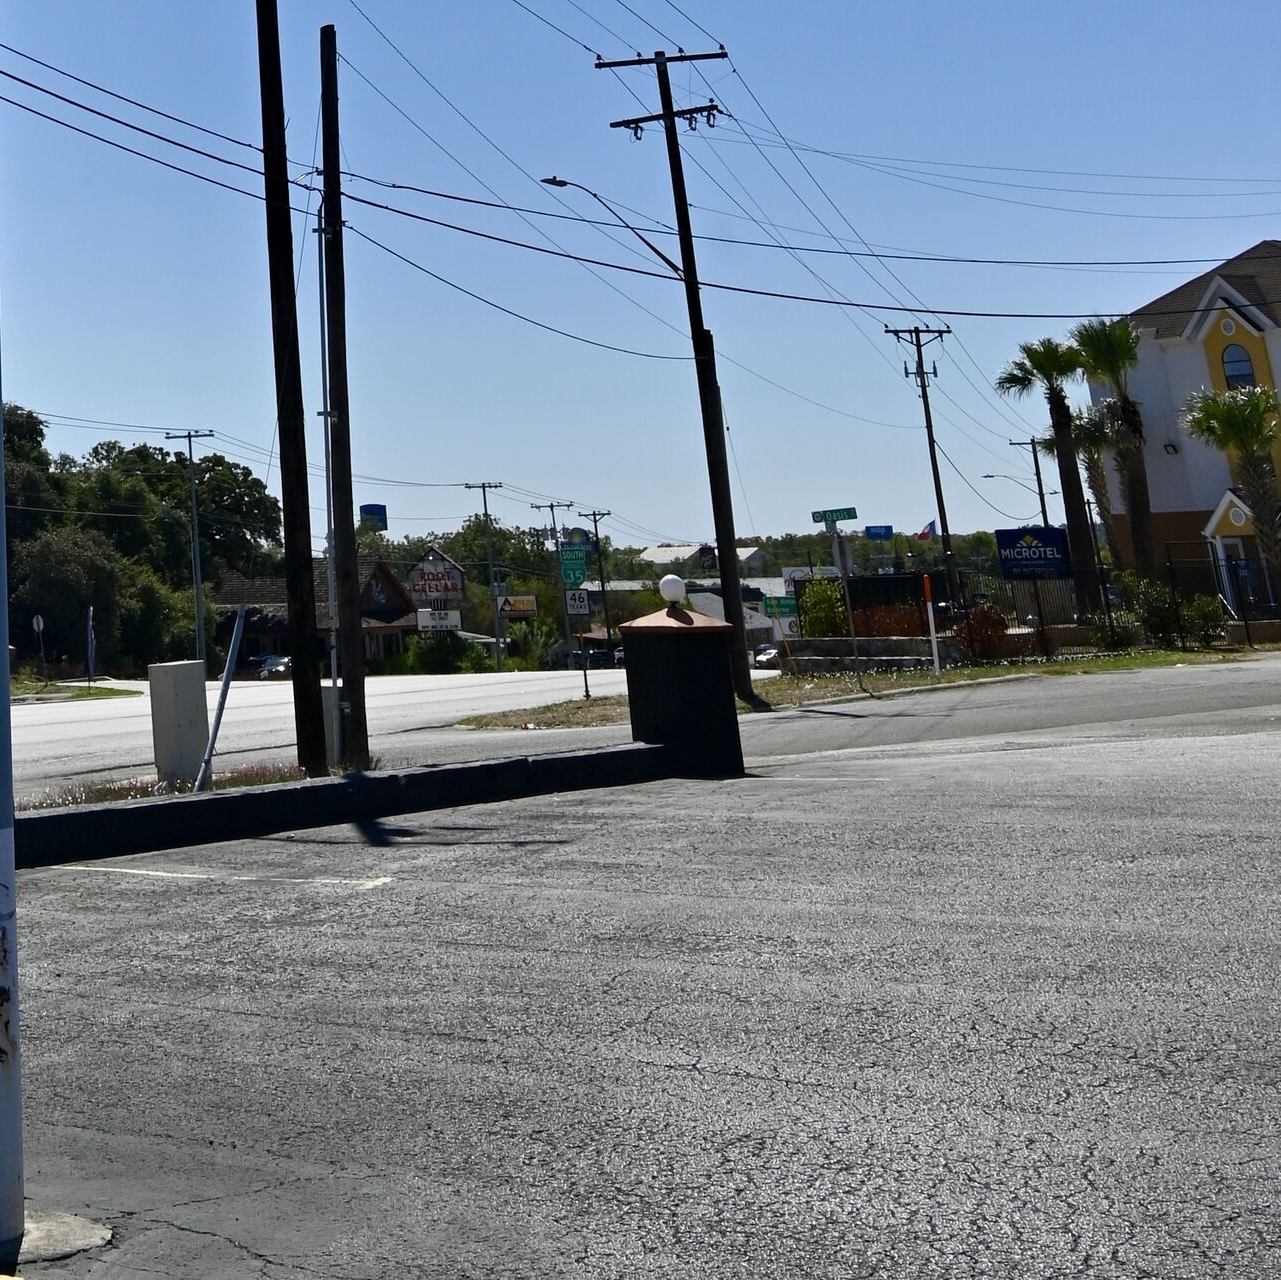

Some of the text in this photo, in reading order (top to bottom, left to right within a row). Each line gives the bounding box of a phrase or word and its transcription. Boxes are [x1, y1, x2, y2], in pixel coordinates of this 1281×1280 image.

[826, 511, 849, 521] Oasis
[562, 551, 584, 559] SOUTH
[1000, 547, 1062, 559] MICROTEL
[420, 571, 451, 581] ROOT
[566, 571, 583, 583] 35
[413, 582, 459, 593] CELLAR
[569, 592, 585, 603] 46
